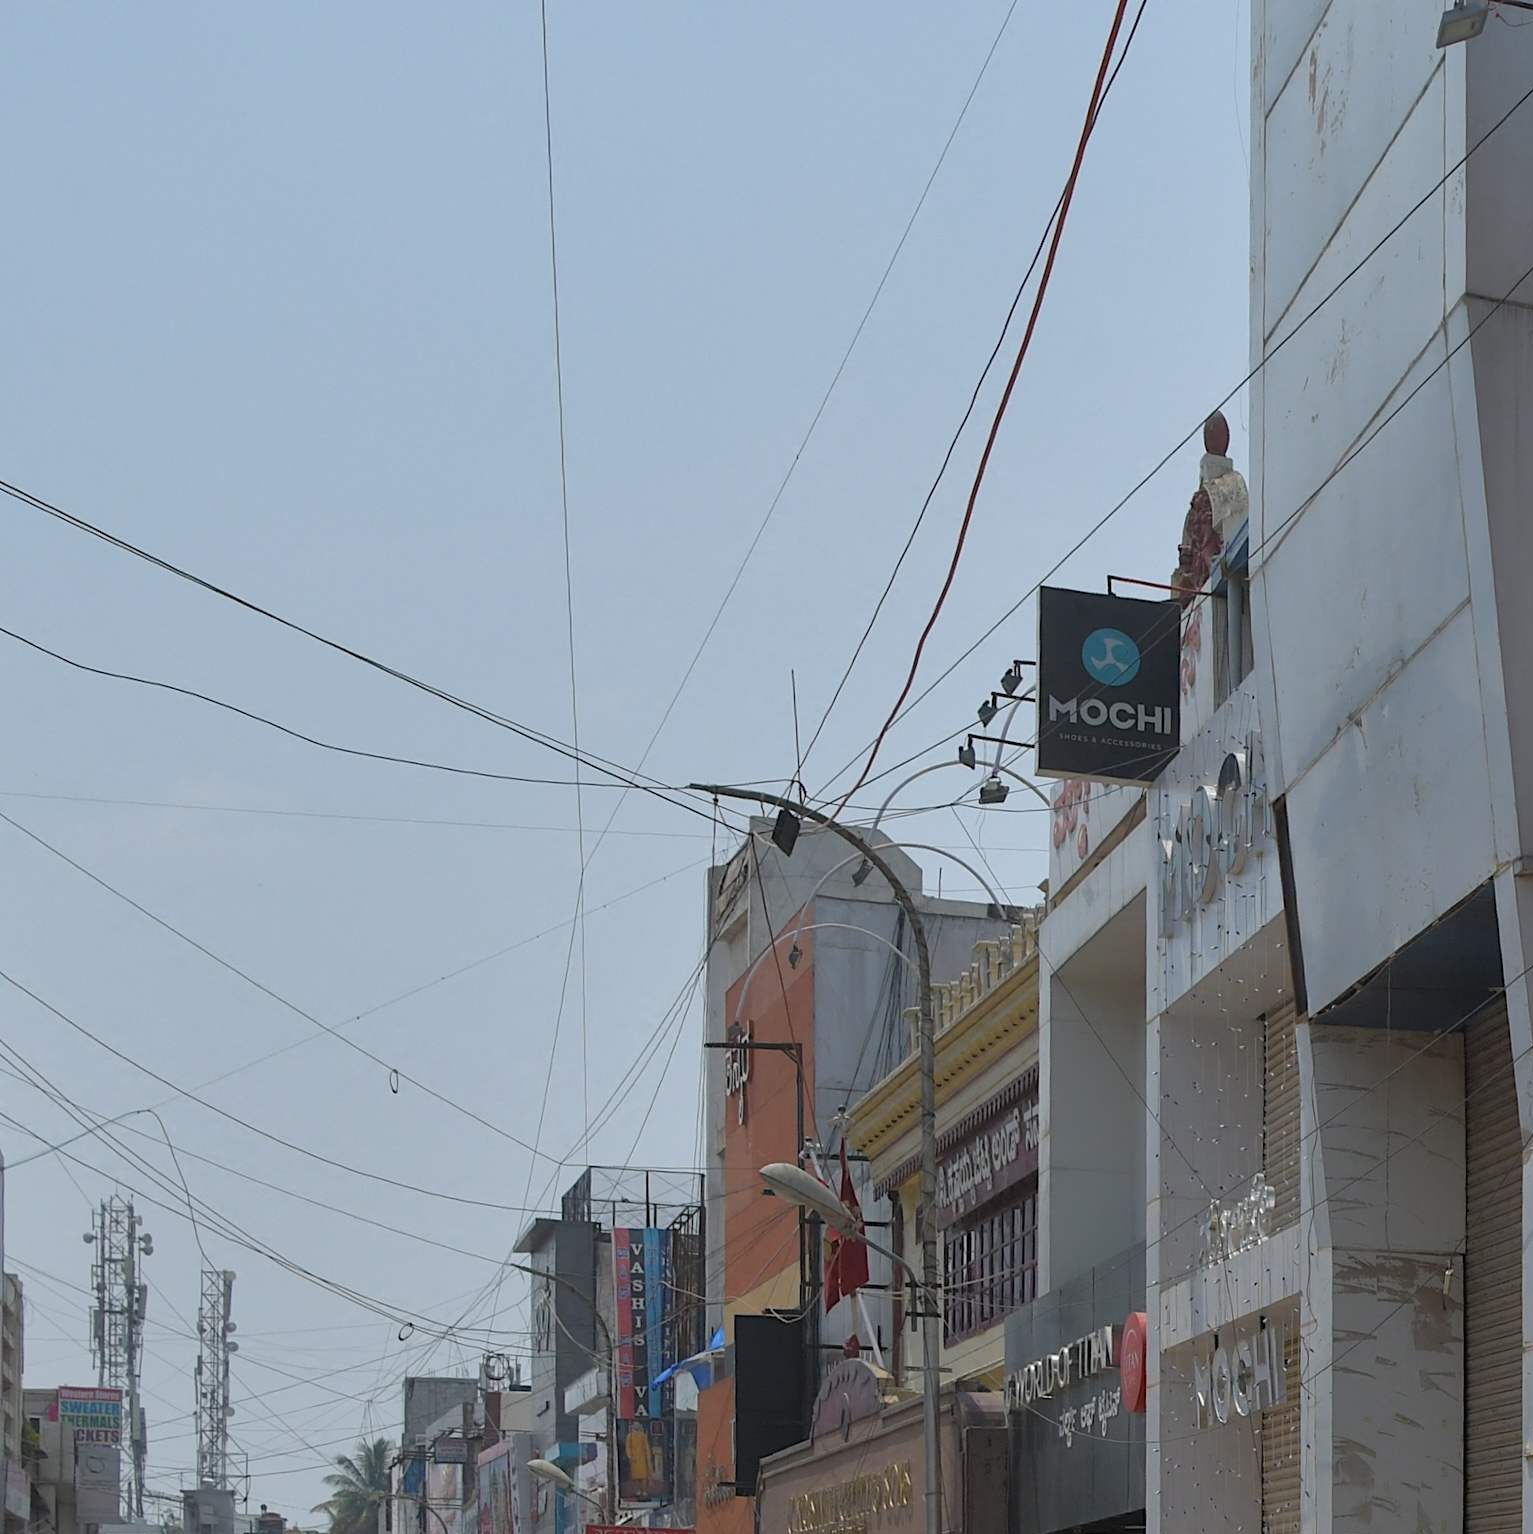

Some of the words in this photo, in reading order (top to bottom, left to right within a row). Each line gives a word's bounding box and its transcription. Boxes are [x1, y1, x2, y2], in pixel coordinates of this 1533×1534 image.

[1049, 694, 1172, 735] MOCHI
[1058, 733, 1089, 743] SHOES
[1091, 735, 1097, 744] &
[1100, 737, 1163, 751] ACCESSORIES
[1014, 1354, 1055, 1408] WORLD
[1057, 1343, 1074, 1388] OF
[1076, 1324, 1113, 1379] TITAN
[60, 1414, 120, 1429] THERMALS
[76, 1429, 120, 1443] CKETS
